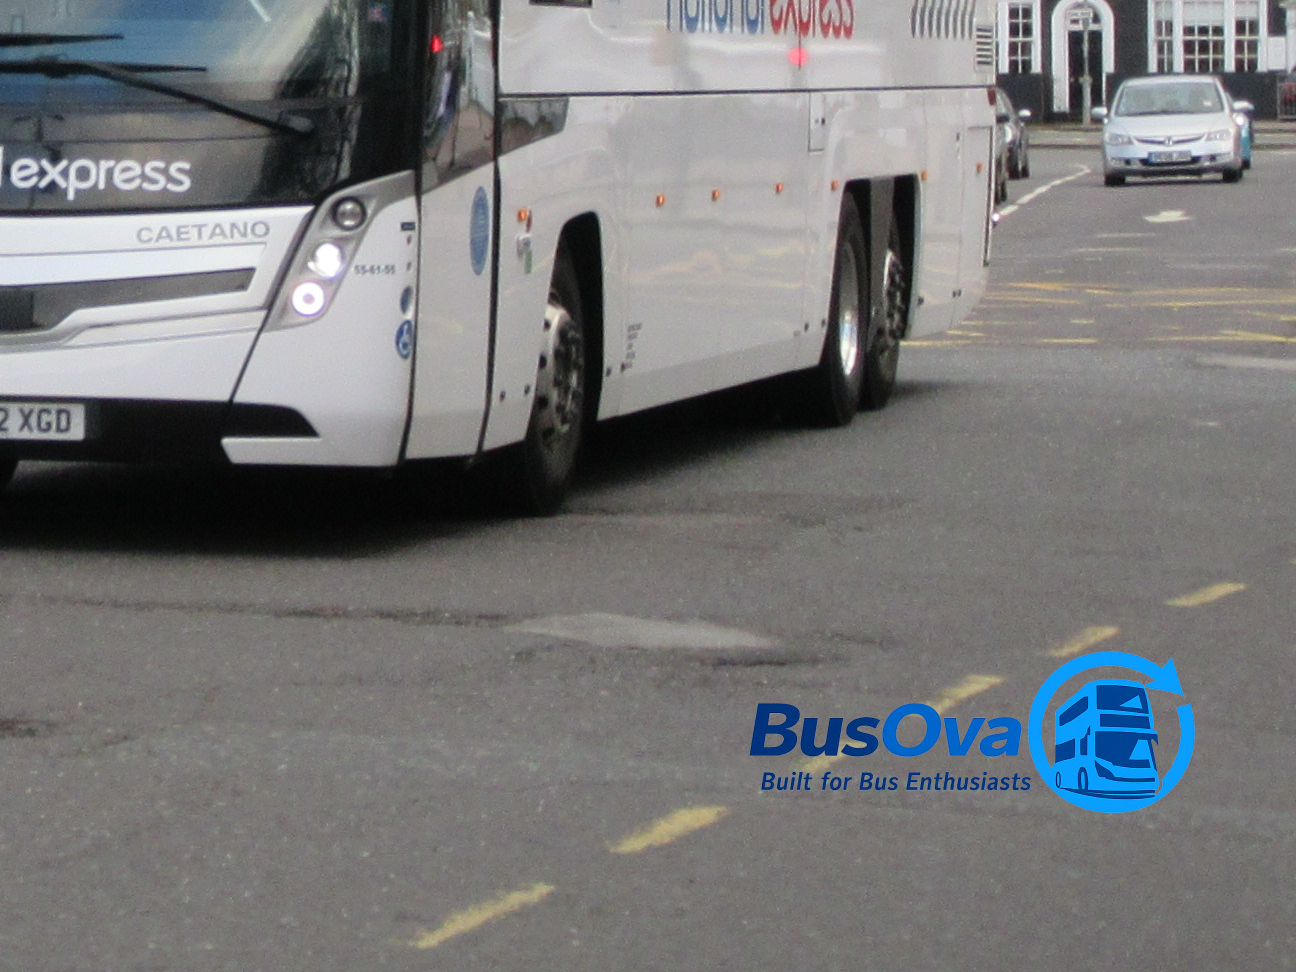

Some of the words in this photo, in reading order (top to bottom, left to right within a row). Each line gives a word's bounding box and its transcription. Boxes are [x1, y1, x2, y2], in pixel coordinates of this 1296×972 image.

[10, 157, 192, 201] express
[136, 220, 271, 244] CAETANO
[18, 407, 72, 433] XGD
